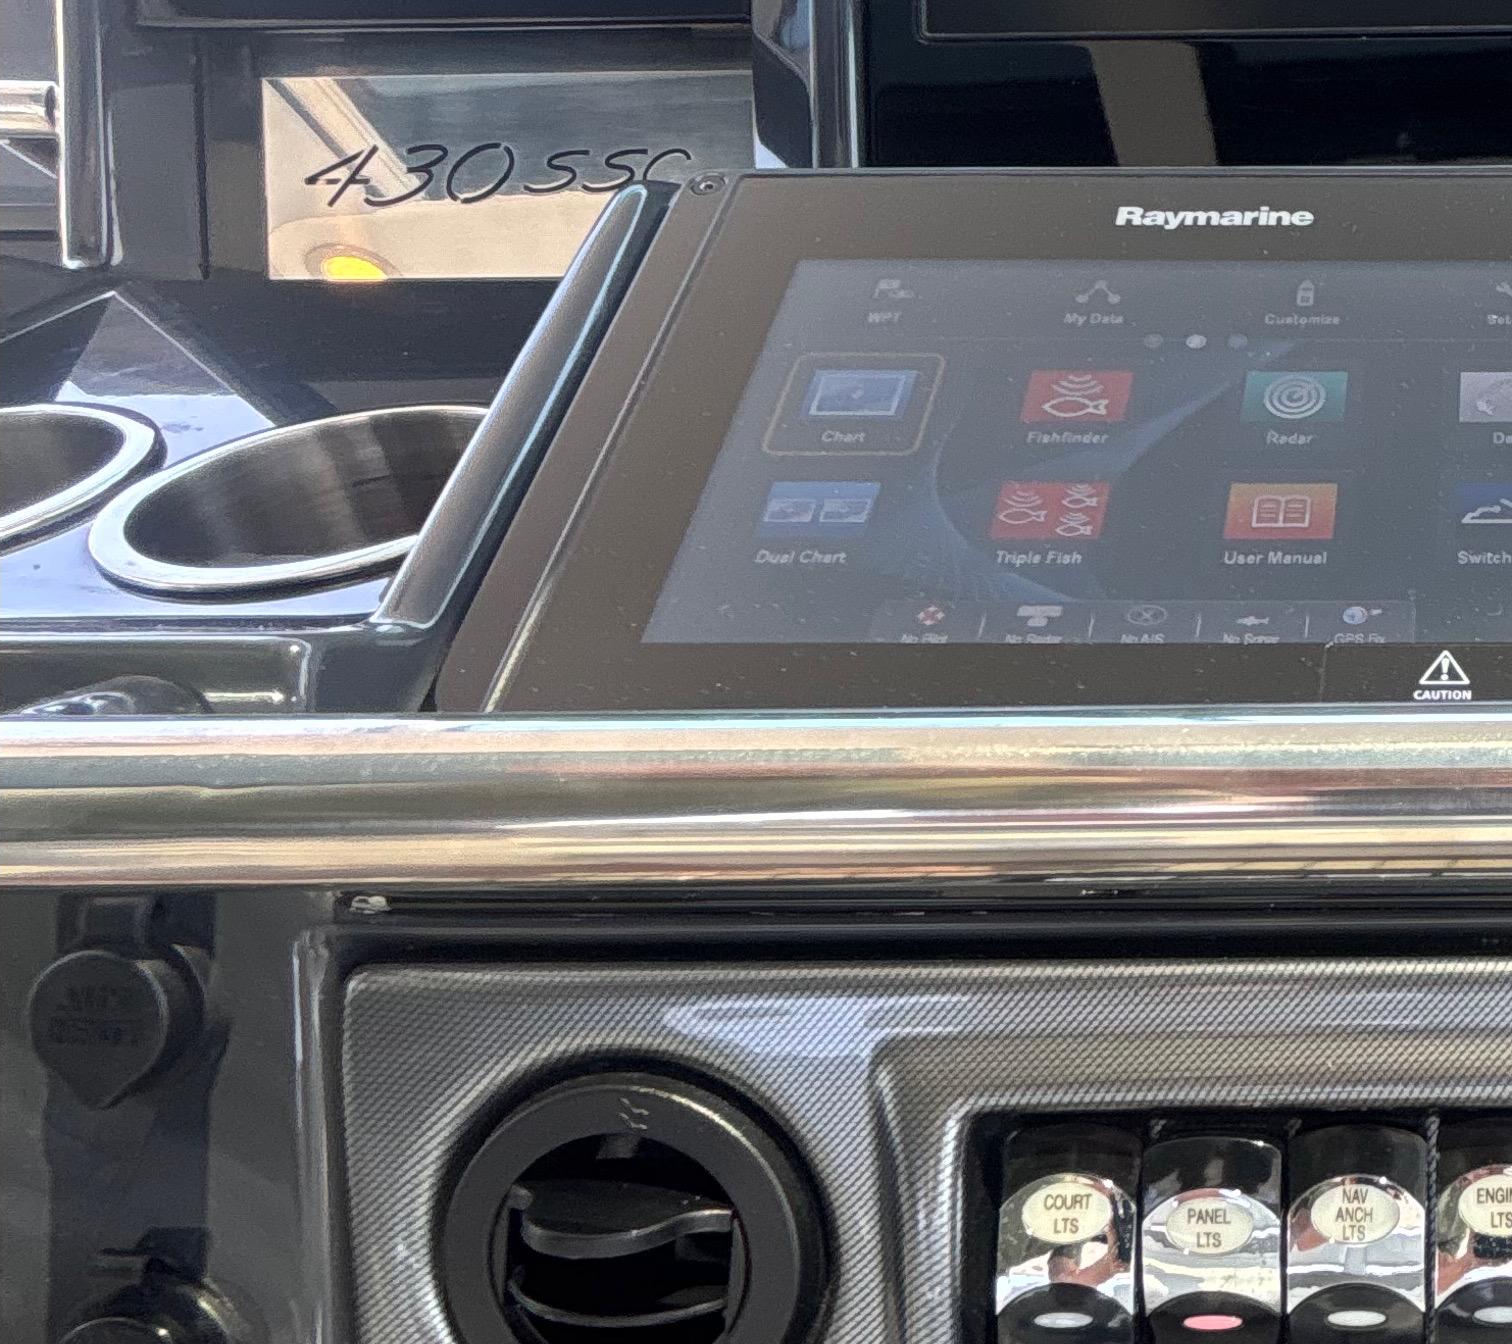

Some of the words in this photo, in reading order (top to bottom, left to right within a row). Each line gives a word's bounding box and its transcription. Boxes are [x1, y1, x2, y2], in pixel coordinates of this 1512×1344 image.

[1115, 205, 1315, 230] Raymarine
[1090, 312, 1124, 324] Data
[1264, 313, 1340, 326] Customize
[821, 429, 867, 443] Chart
[1025, 430, 1109, 445] Fishfinder
[1265, 430, 1314, 445] Radar
[754, 549, 794, 565] Dual
[799, 549, 848, 564] Chart
[996, 550, 1042, 567] Triple
[1045, 550, 1083, 564] Fish
[1223, 551, 1265, 566] User
[1268, 551, 1327, 565] Manual
[1457, 551, 1512, 565] Switch
[1413, 690, 1472, 701] CAUTION
[1044, 1193, 1092, 1211] COURT
[1342, 1188, 1368, 1205] NAV
[1187, 1208, 1231, 1226] PANEL
[1335, 1207, 1373, 1223] ANCH
[1053, 1217, 1079, 1235] LTS
[1342, 1224, 1366, 1242] LTS
[1196, 1231, 1222, 1249] LTS
